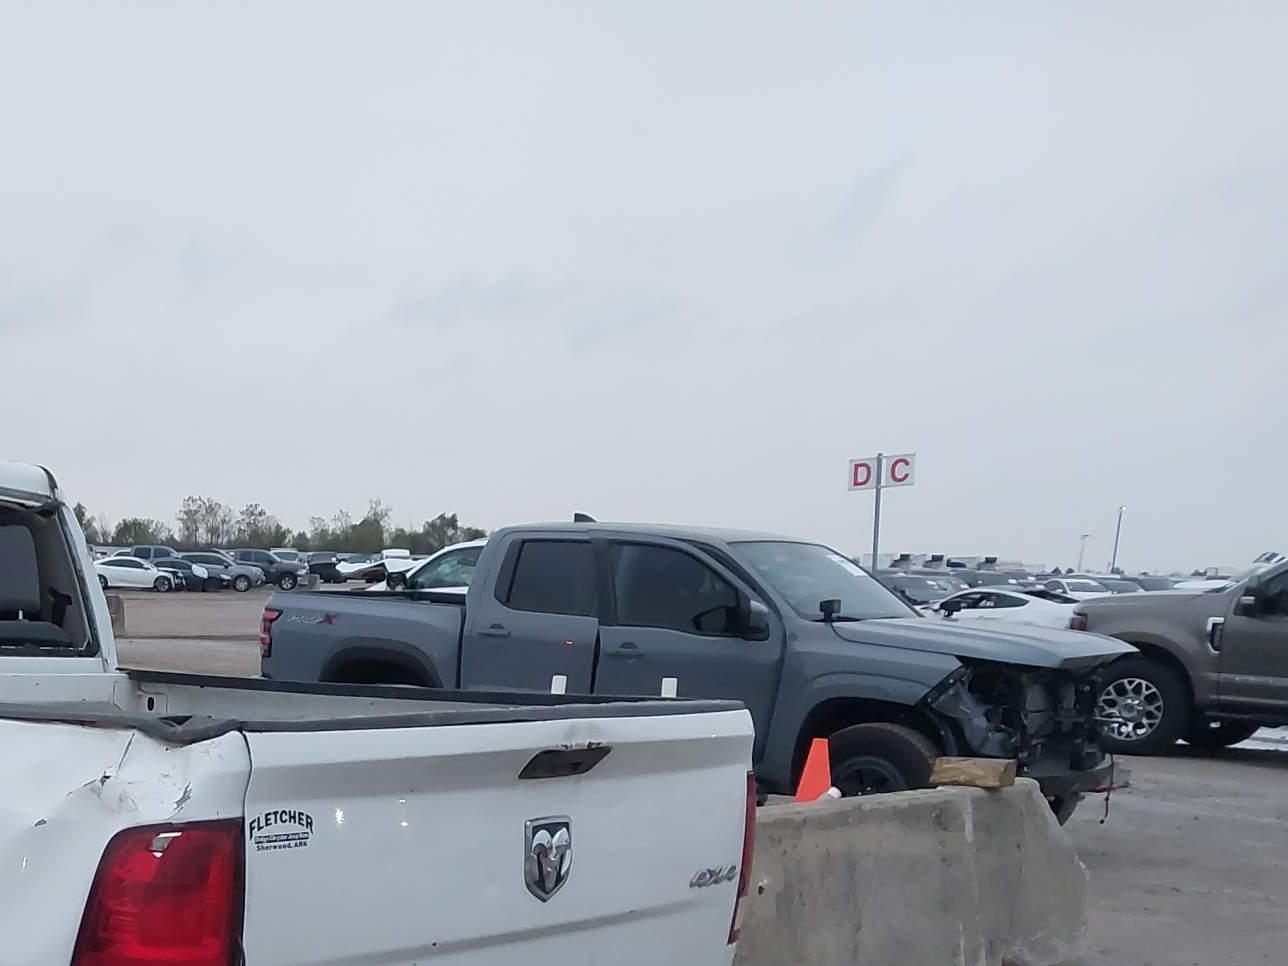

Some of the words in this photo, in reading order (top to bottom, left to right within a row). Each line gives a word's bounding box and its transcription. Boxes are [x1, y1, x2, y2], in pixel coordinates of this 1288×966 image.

[853, 462, 872, 487] D
[890, 458, 910, 483] C
[249, 810, 314, 840] FLETCHER
[256, 843, 292, 851] Sherwood,
[294, 840, 308, 848] ARK
